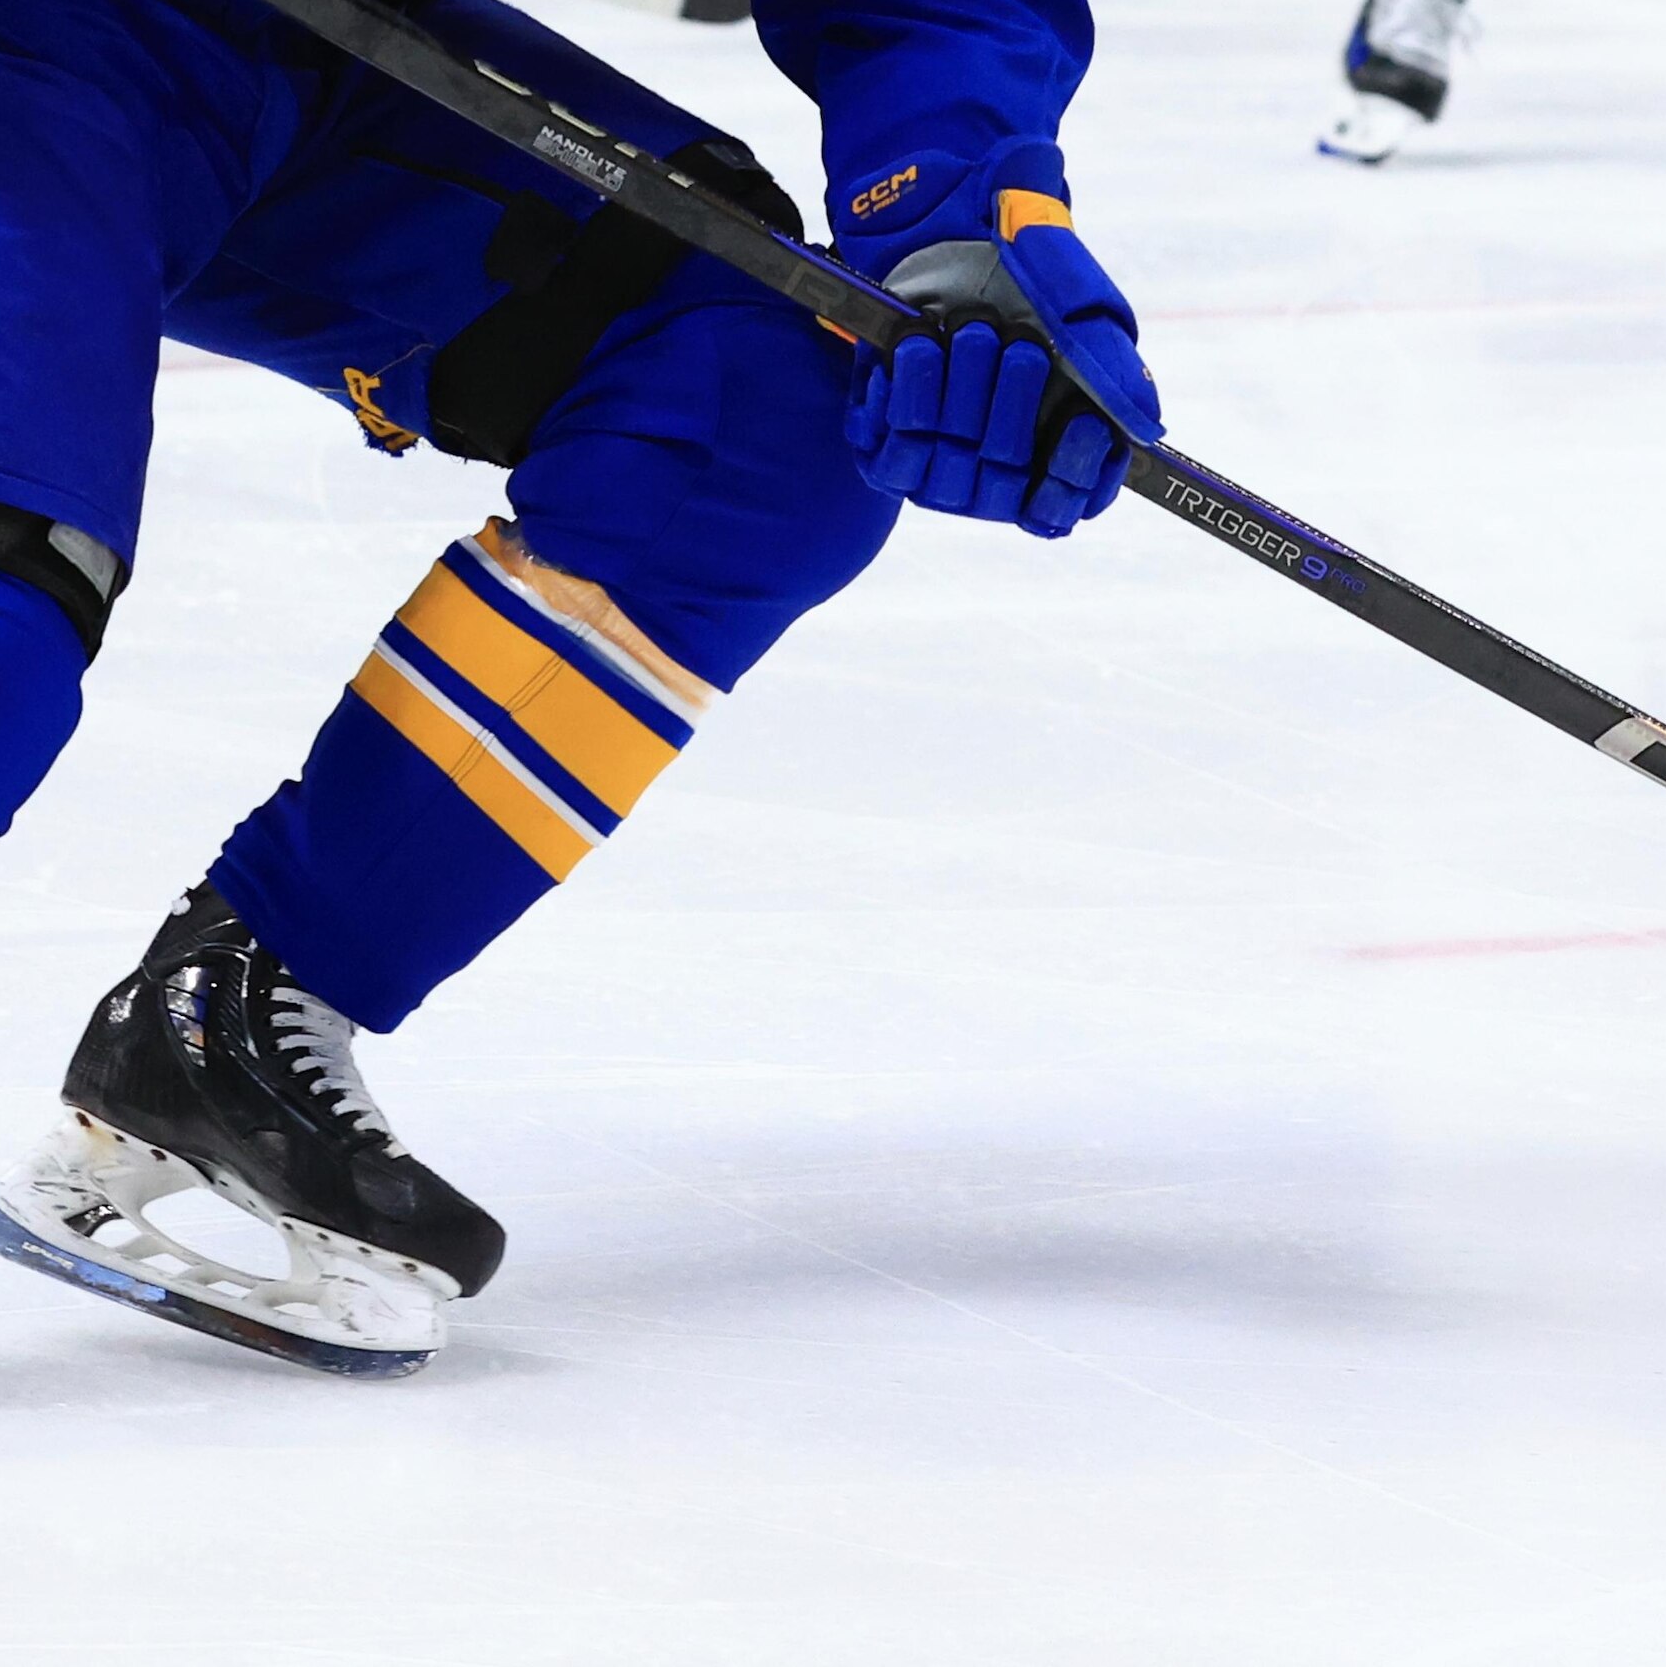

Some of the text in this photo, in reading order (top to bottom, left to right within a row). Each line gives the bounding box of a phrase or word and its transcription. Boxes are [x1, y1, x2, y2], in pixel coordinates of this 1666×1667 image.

[538, 125, 628, 177] NANOLITE
[851, 164, 917, 215] CCM
[1163, 475, 1367, 595] TRIGGER 9 PRO
